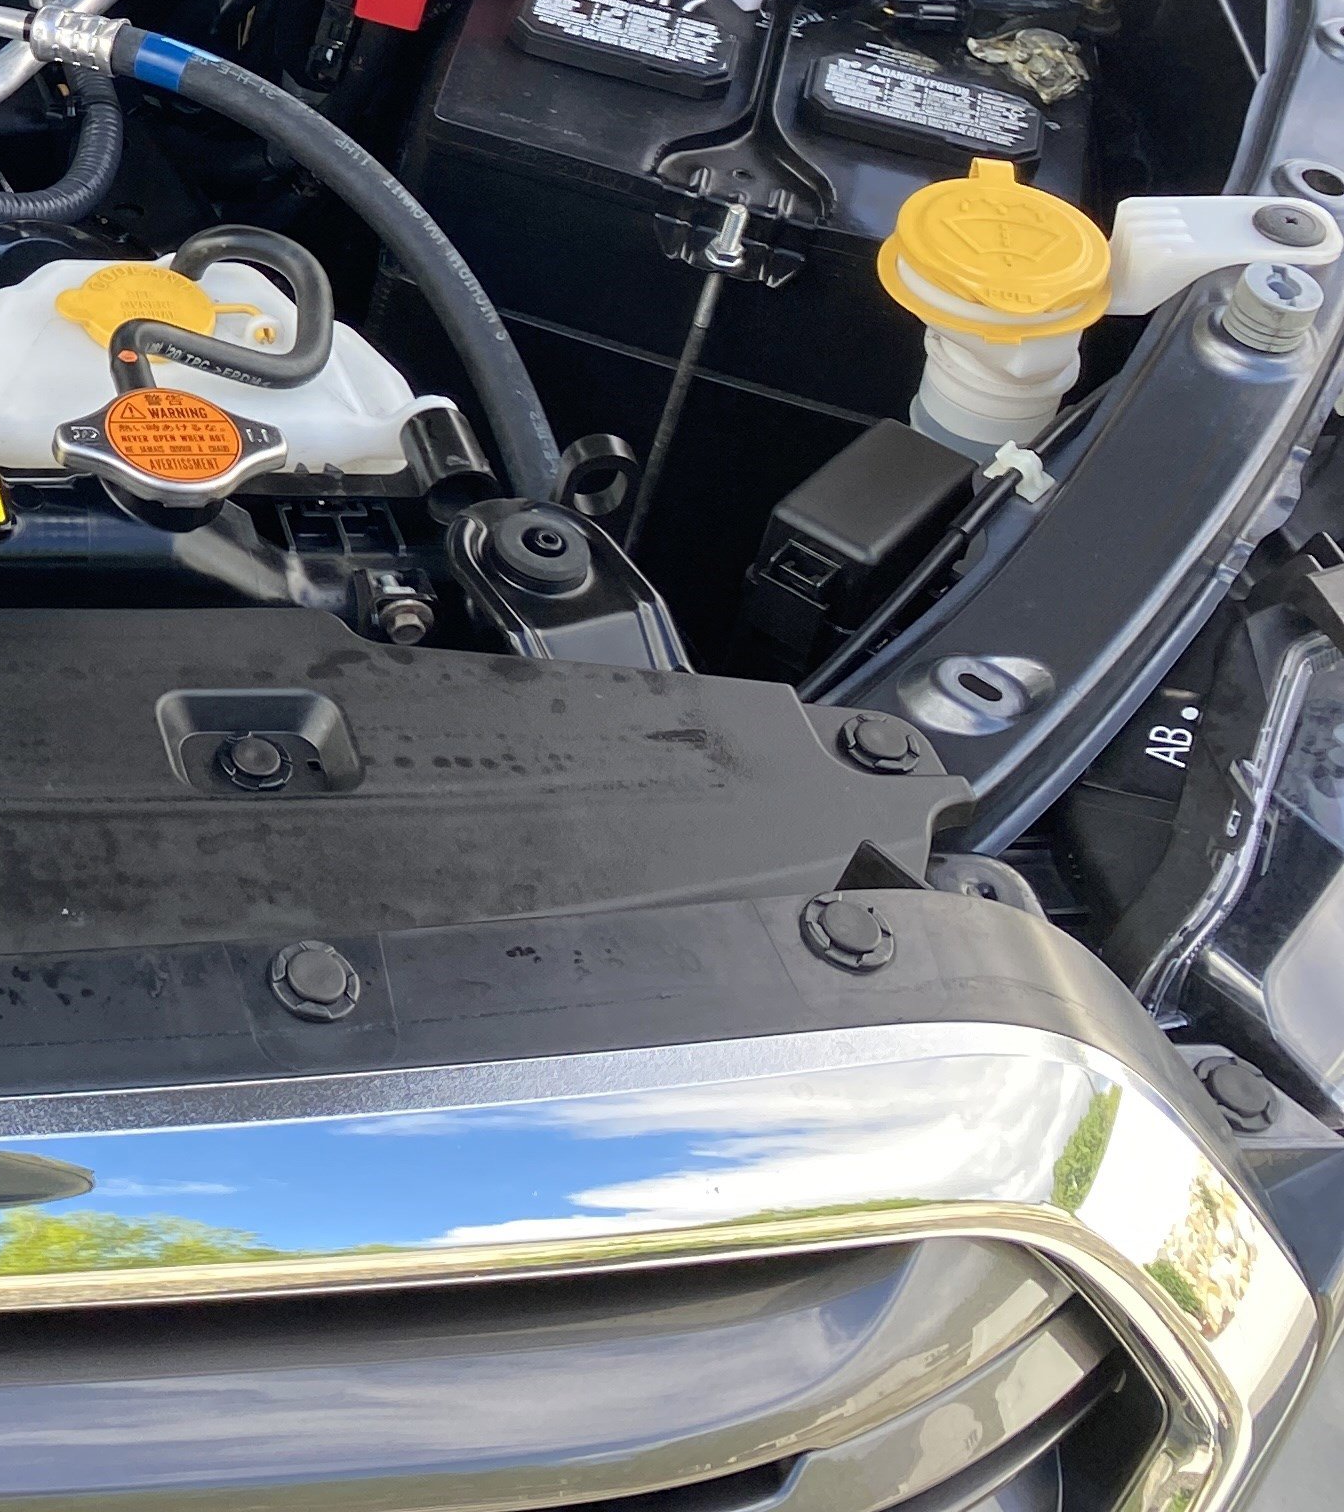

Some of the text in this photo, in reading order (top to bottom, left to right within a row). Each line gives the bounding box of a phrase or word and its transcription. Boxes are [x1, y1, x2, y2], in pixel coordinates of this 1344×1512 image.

[881, 67, 970, 97] DANGER/POISON
[186, 353, 211, 370] TPC
[148, 407, 208, 420] WARNING
[121, 434, 148, 443] NEVER
[153, 434, 176, 443] OPEN
[180, 434, 205, 443] WHEN
[1146, 726, 1193, 768] AB
